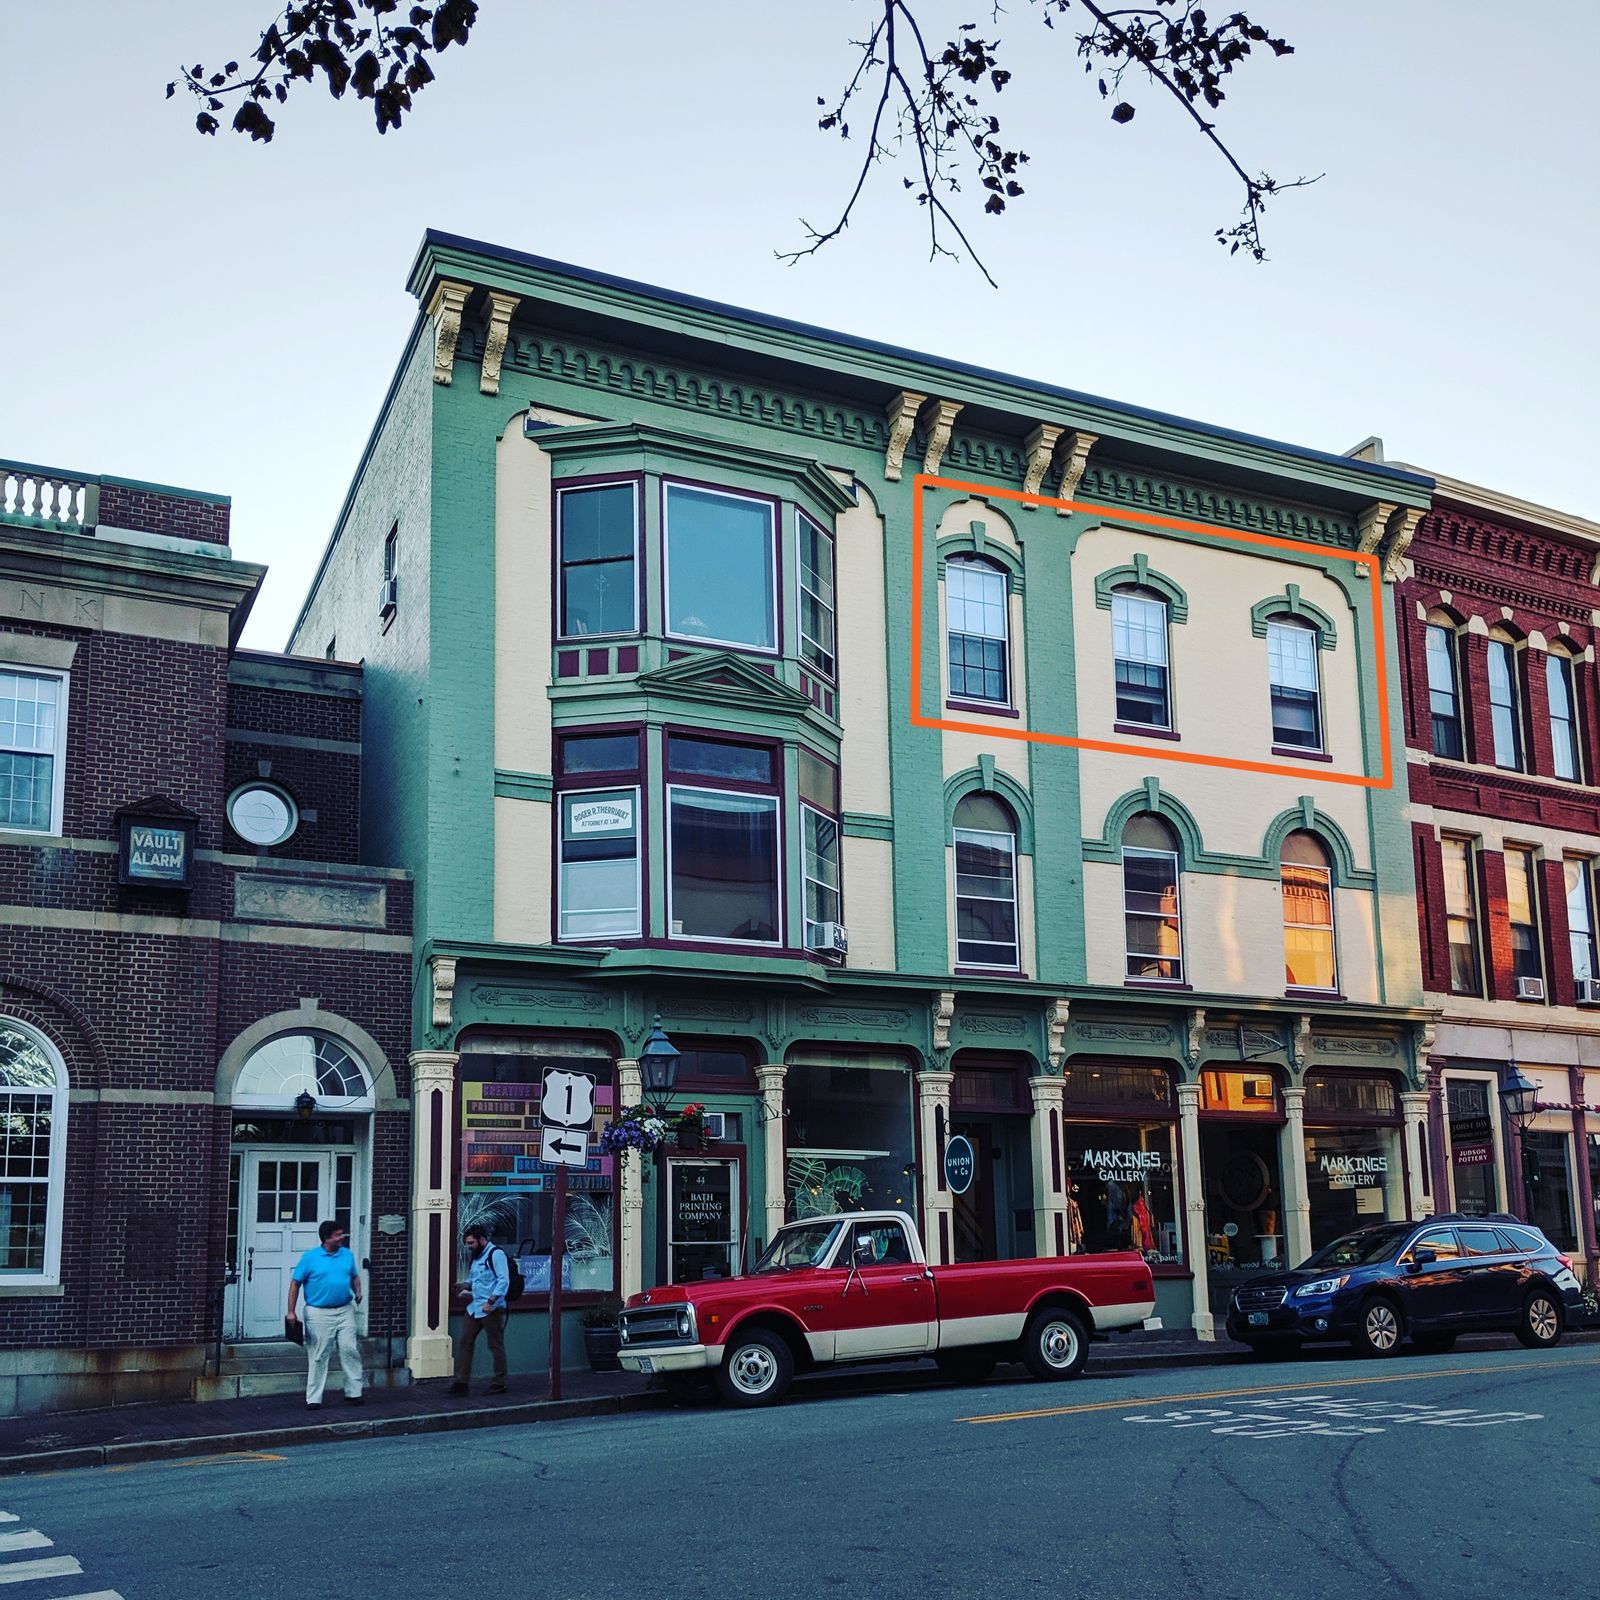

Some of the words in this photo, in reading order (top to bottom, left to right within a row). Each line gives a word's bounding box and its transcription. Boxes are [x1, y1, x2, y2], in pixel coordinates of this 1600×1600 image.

[574, 808, 592, 822] ROGER
[597, 806, 630, 820] THERRIAULT
[581, 819, 603, 827] ATTORNEY
[133, 833, 180, 850] VAULT
[132, 851, 183, 868] ALARM
[484, 1085, 531, 1097] CREATIVE
[565, 1084, 573, 1115] 1
[471, 1102, 516, 1112] PRINTING
[1475, 1120, 1488, 1128] DAY
[1459, 1148, 1486, 1156] JUDSON
[947, 1157, 970, 1167] UNION
[1083, 1149, 1161, 1169] MARKINGS
[1320, 1154, 1388, 1174] MARKINGS
[1458, 1155, 1488, 1163] POTTERY
[696, 1176, 705, 1184] 44
[1098, 1170, 1147, 1182] GALLERY
[1334, 1174, 1376, 1184] GALLERY
[545, 1176, 610, 1189] ERAVING
[690, 1193, 714, 1202] BATH
[679, 1202, 722, 1211] PRINTING
[678, 1212, 722, 1220] COMPANY
[1159, 1254, 1179, 1263] paint
[1224, 1395, 1544, 1427] AHEAD
[1122, 1409, 1386, 1438] STOP
